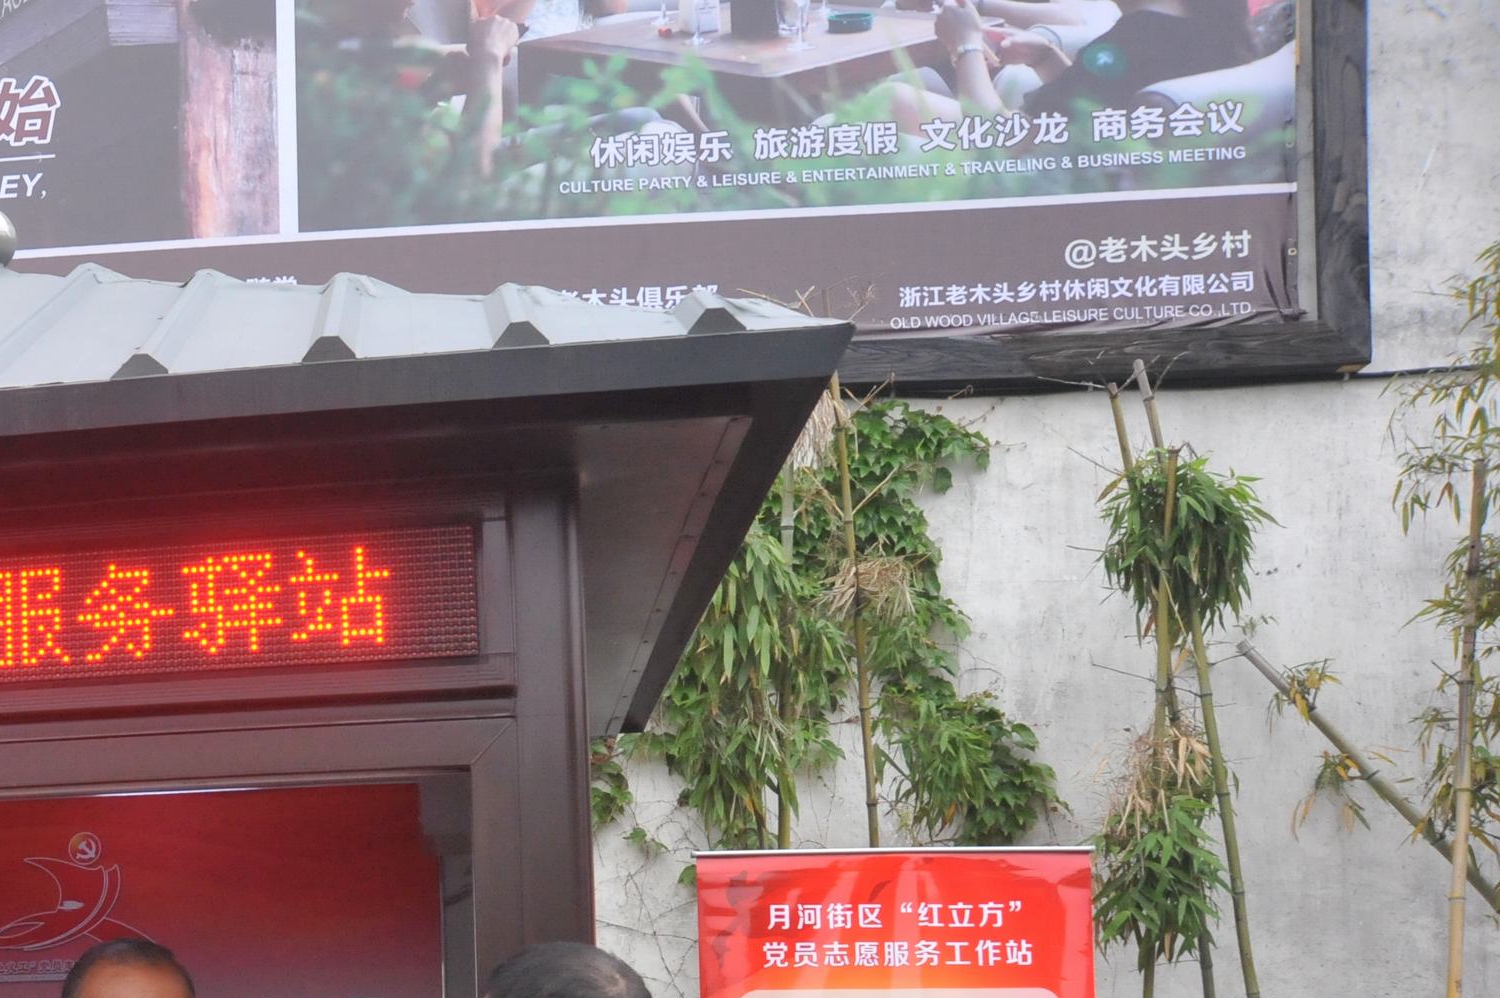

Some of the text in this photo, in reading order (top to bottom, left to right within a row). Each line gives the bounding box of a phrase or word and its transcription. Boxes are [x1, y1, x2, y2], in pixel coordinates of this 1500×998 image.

[590, 100, 1245, 168] 休闲娱乐 旅游度假 文化沙龙 商务会议
[559, 146, 1246, 194] CULTURE PARTY & LEISURE & ENTERTAINMENT & TRAVELING & BUSINESS MEETING
[1065, 230, 1252, 269] @老木头乡村
[562, 284, 718, 309] 木头俱乐
[899, 271, 1255, 308] 浙江老木头乡村休闲文化有限公司
[890, 315, 921, 330] OLD
[924, 313, 974, 328] WOOD
[977, 311, 1039, 327] VILLAGE
[1044, 307, 1108, 323] LEISURE
[1113, 303, 1184, 320] CULTURE
[762, 940, 1034, 968] 党员志愿服务工作站
